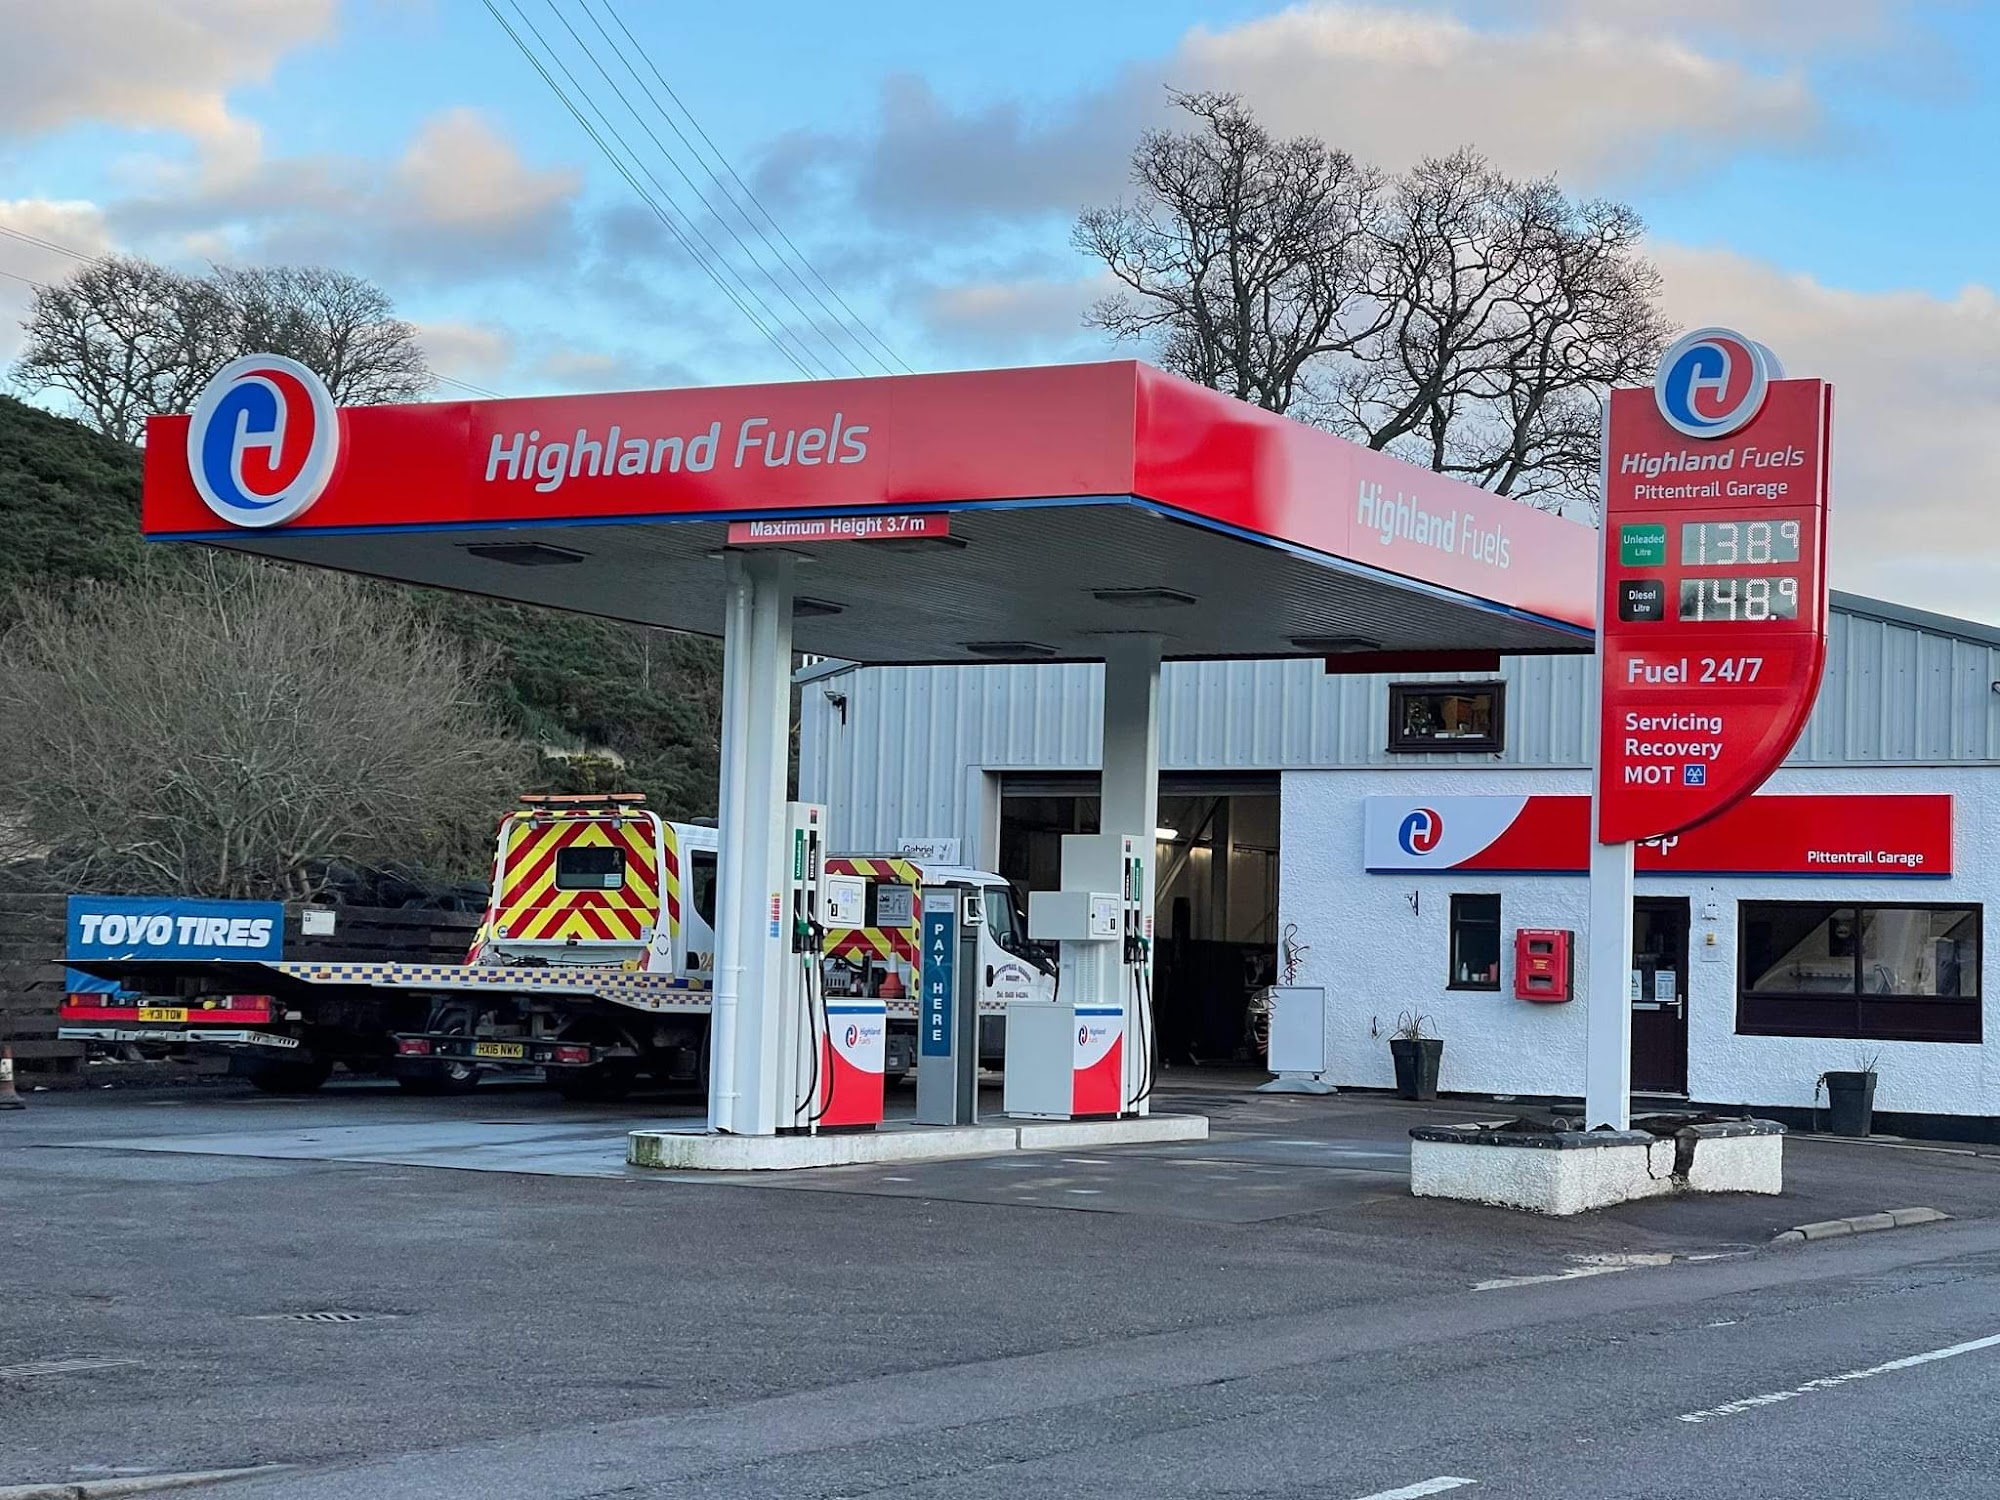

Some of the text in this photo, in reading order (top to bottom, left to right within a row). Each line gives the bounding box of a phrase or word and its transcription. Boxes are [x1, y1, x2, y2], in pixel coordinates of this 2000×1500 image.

[485, 412, 870, 493] Highland Fuels
[1621, 445, 1805, 479] Highland Fuels
[1634, 480, 1789, 500] Pittentrail Garage
[750, 520, 825, 537] Maximum
[830, 517, 882, 536] Height
[1357, 480, 1511, 569] Highland Fuels
[1623, 520, 1800, 566] Unleaded 138.9
[1634, 548, 1652, 557] Litre
[1628, 578, 1798, 621] Diesel 148.9
[1633, 602, 1651, 613] Litre
[1627, 657, 1763, 683] Fuel 24/7
[1625, 713, 1723, 735] Servicing
[1625, 739, 1723, 761] Recovery
[1624, 766, 1675, 785] MOT
[1807, 851, 1924, 867] Pittentrail Garage
[80, 914, 273, 948] TOYO TIRES
[932, 923, 945, 1041] PAY HERE
